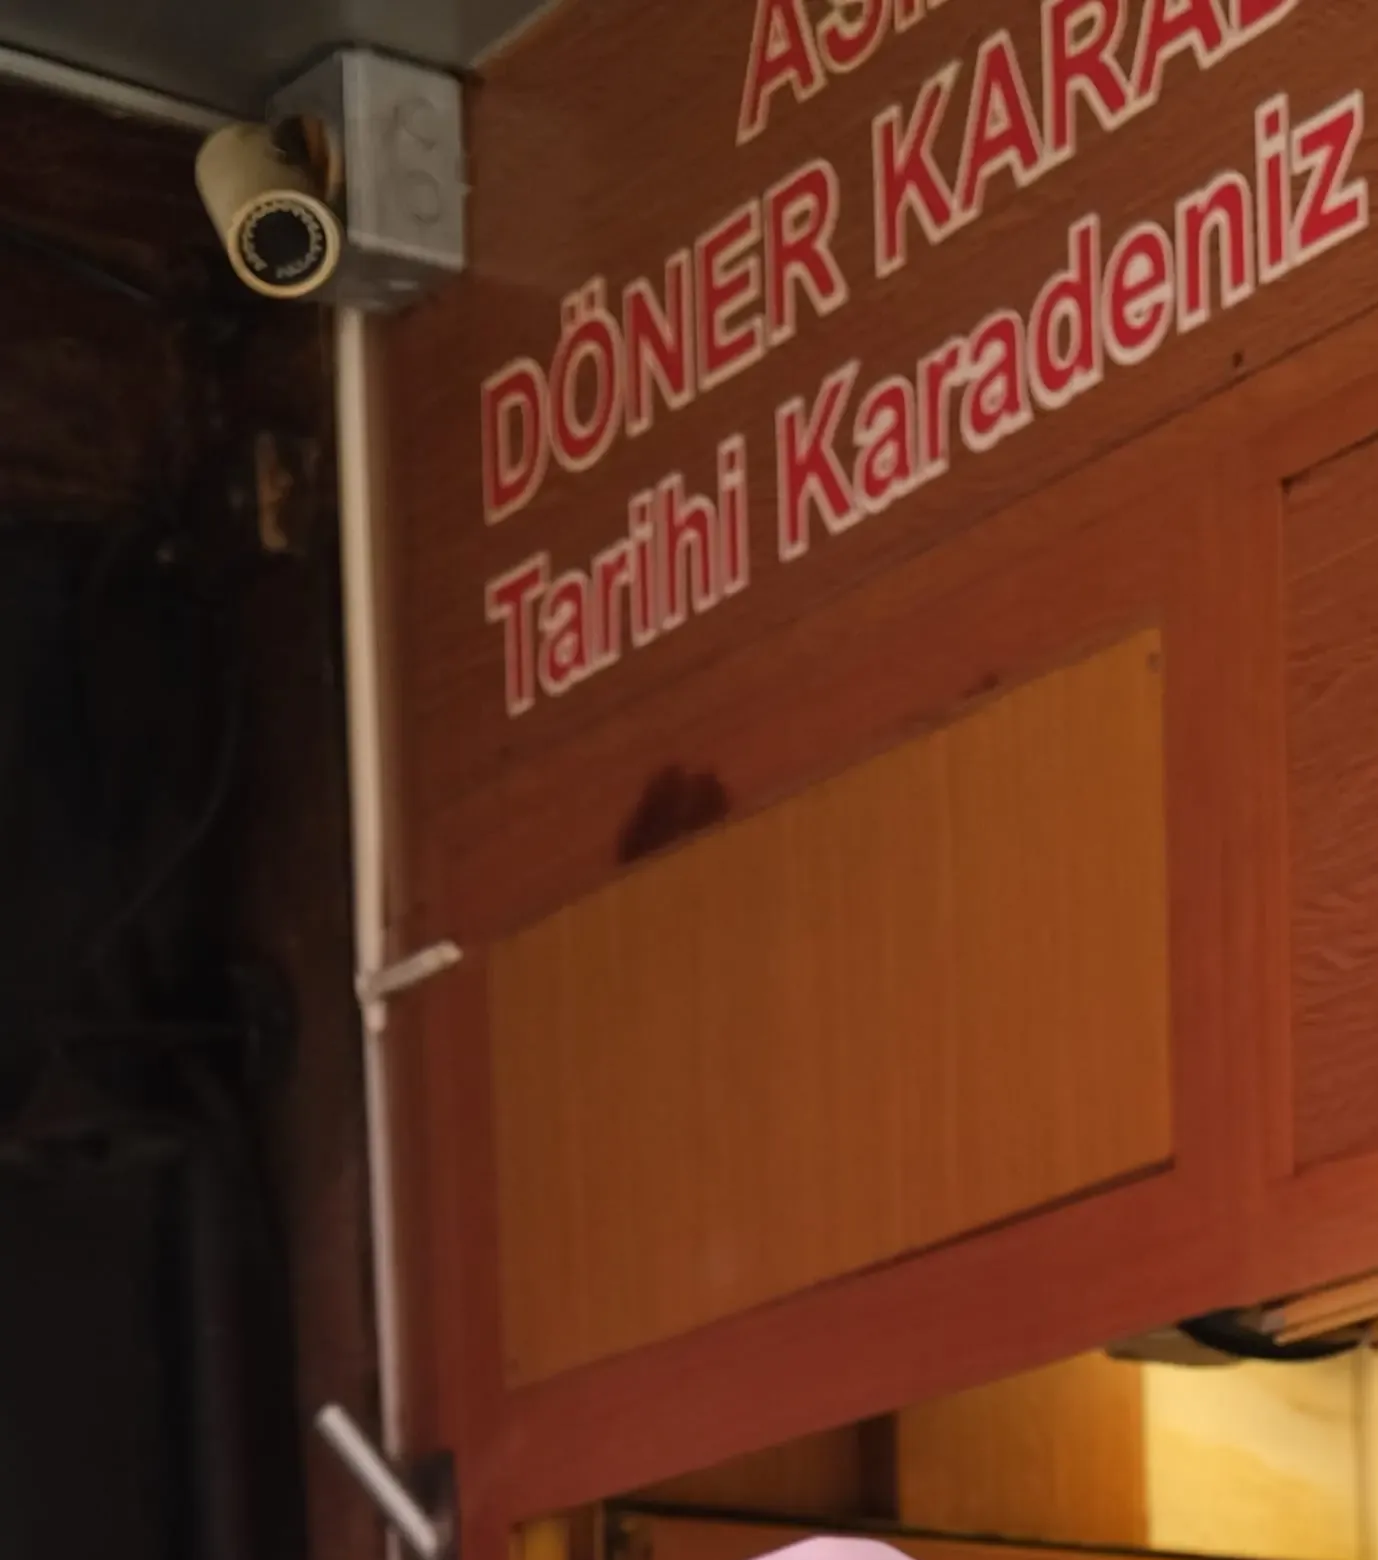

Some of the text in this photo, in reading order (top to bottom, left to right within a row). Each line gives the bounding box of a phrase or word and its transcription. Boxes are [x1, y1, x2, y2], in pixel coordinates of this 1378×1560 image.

[481, 0, 1298, 526] DÖNER KARA
[485, 432, 750, 718] Tarihi
[774, 89, 1368, 562] Karadeniz
